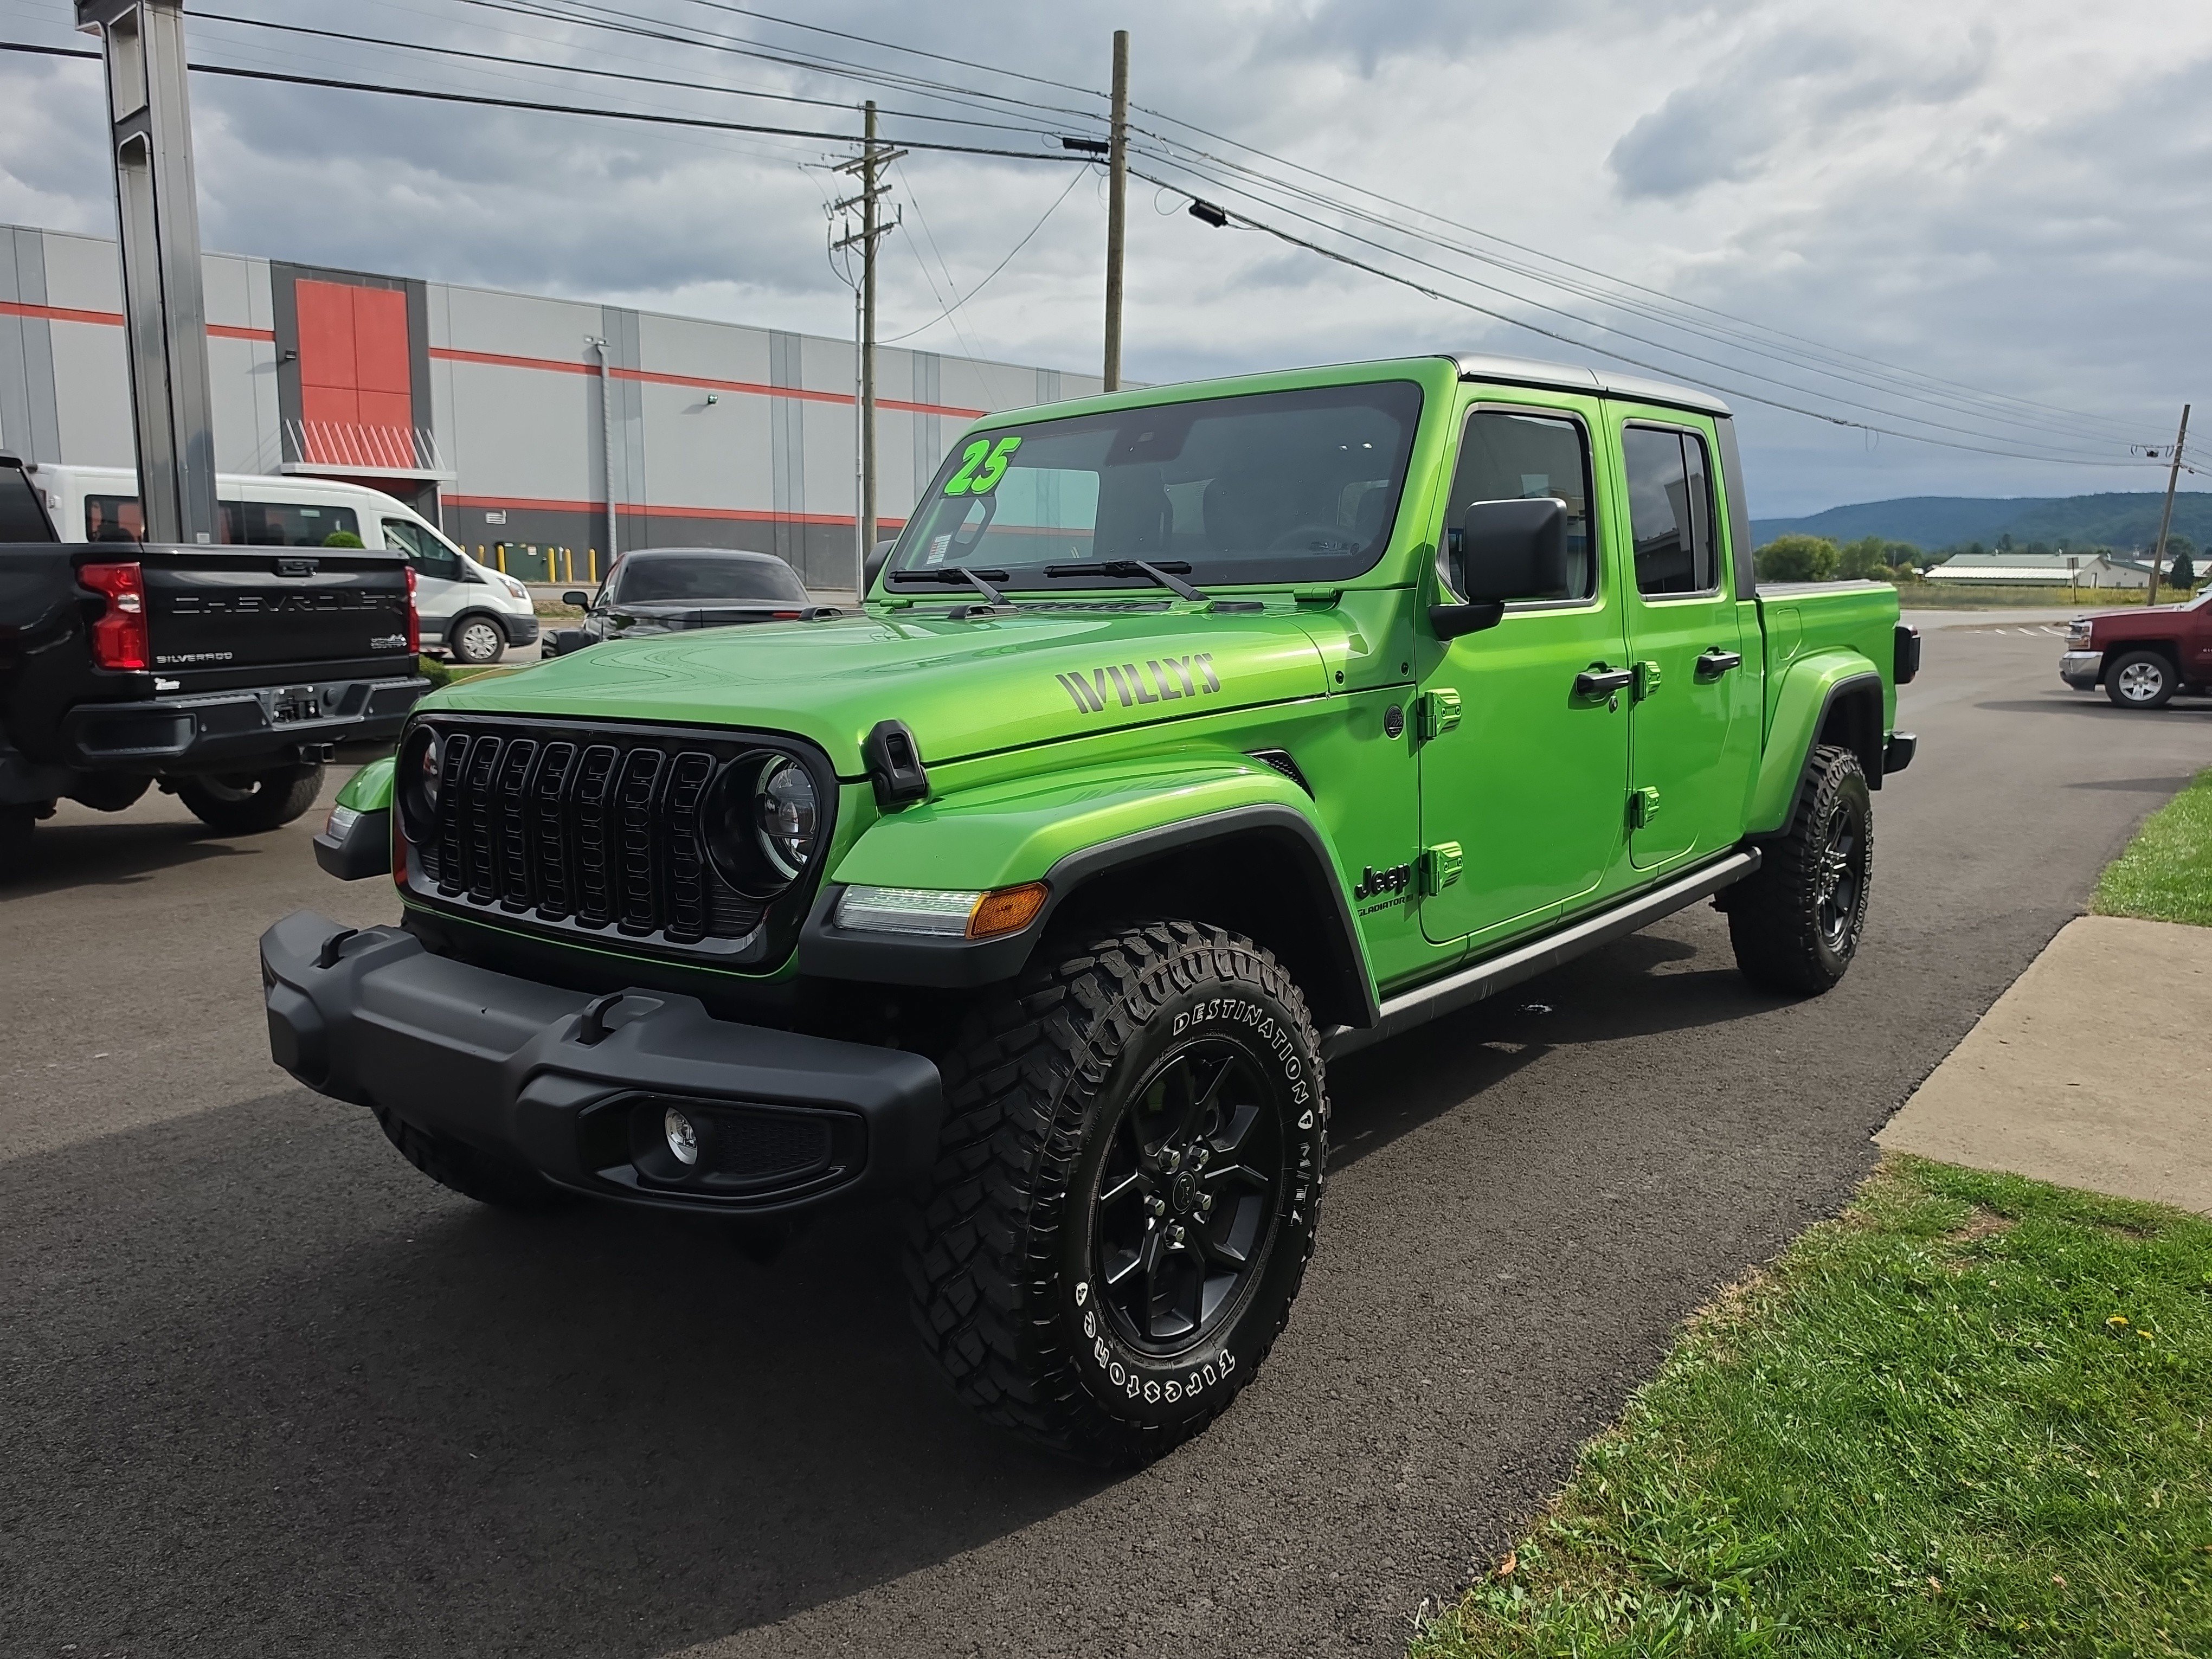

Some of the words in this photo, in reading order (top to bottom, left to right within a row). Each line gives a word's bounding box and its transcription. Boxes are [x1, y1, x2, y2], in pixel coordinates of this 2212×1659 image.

[943, 437, 1022, 496] 25
[172, 591, 403, 615] CHEVROLET
[157, 652, 233, 664] SILVERADO
[1054, 653, 1220, 714] WILLYS
[1354, 863, 1411, 902] Jeep
[1357, 896, 1405, 917] GLADIATOR
[1173, 998, 1309, 1104] DESTINATION
